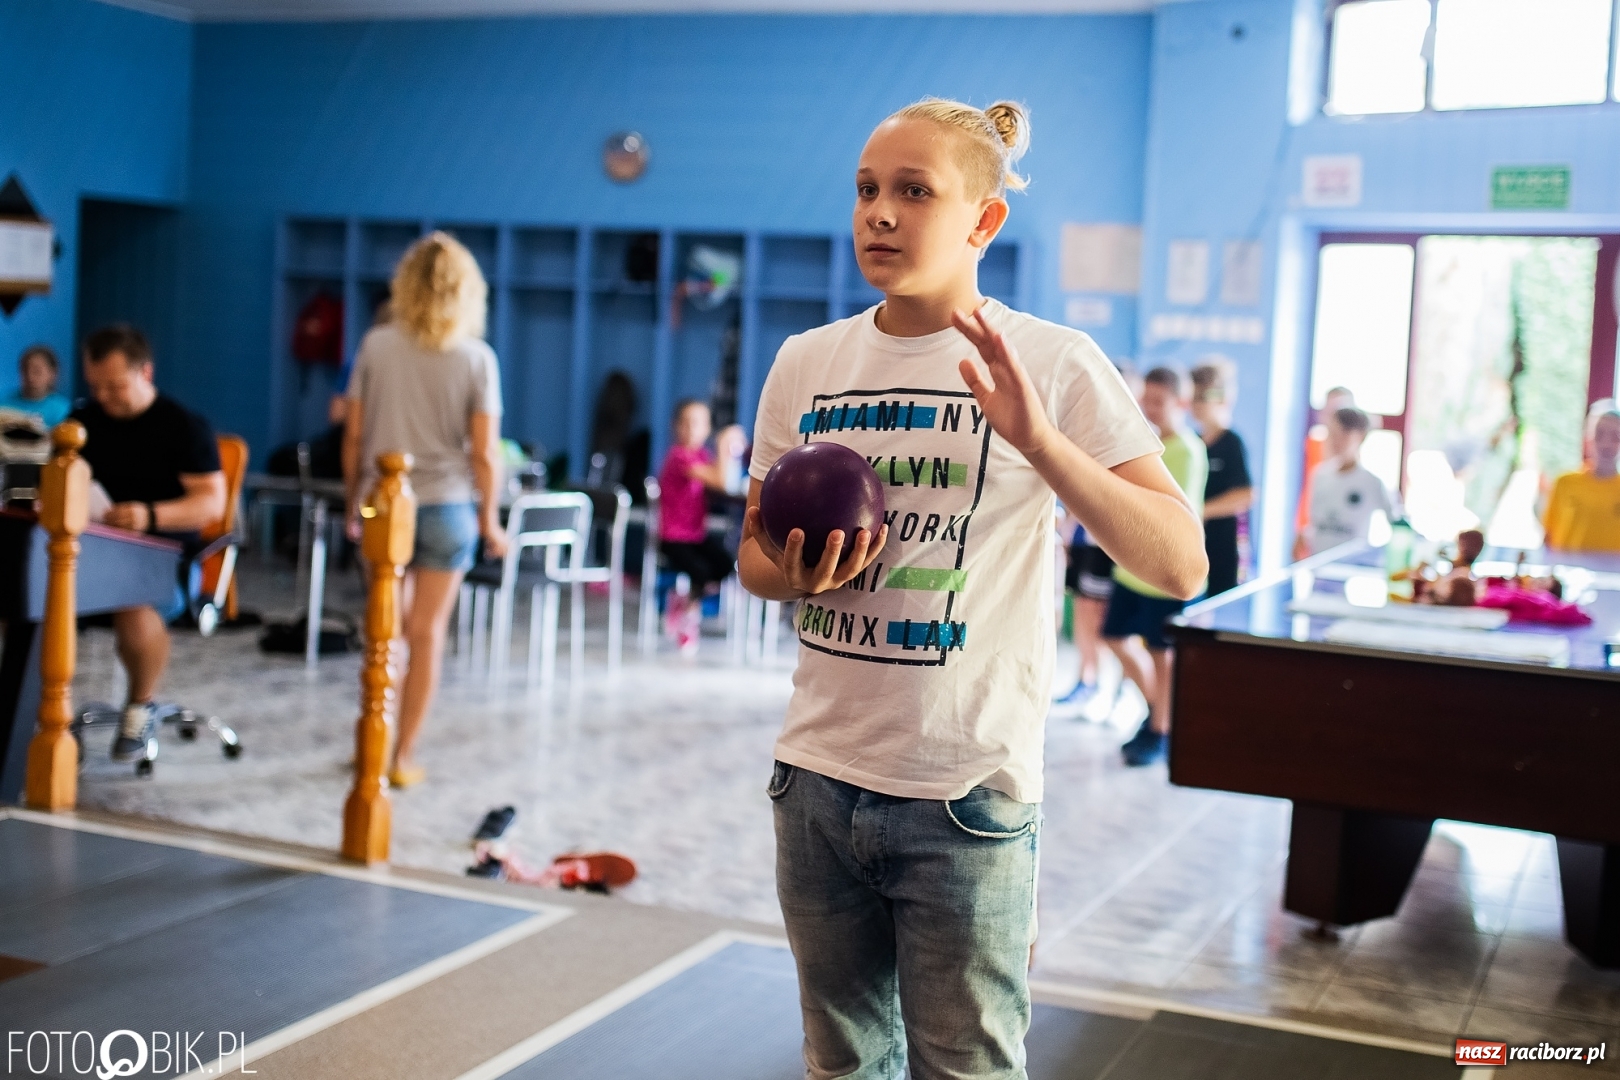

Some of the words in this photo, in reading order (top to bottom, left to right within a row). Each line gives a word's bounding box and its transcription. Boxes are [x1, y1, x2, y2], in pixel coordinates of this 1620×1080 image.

[813, 400, 915, 434] MIAMI
[941, 403, 985, 434] NY
[884, 510, 965, 543] YORK
[802, 603, 879, 647] BRONX
[902, 618, 967, 652] LAX
